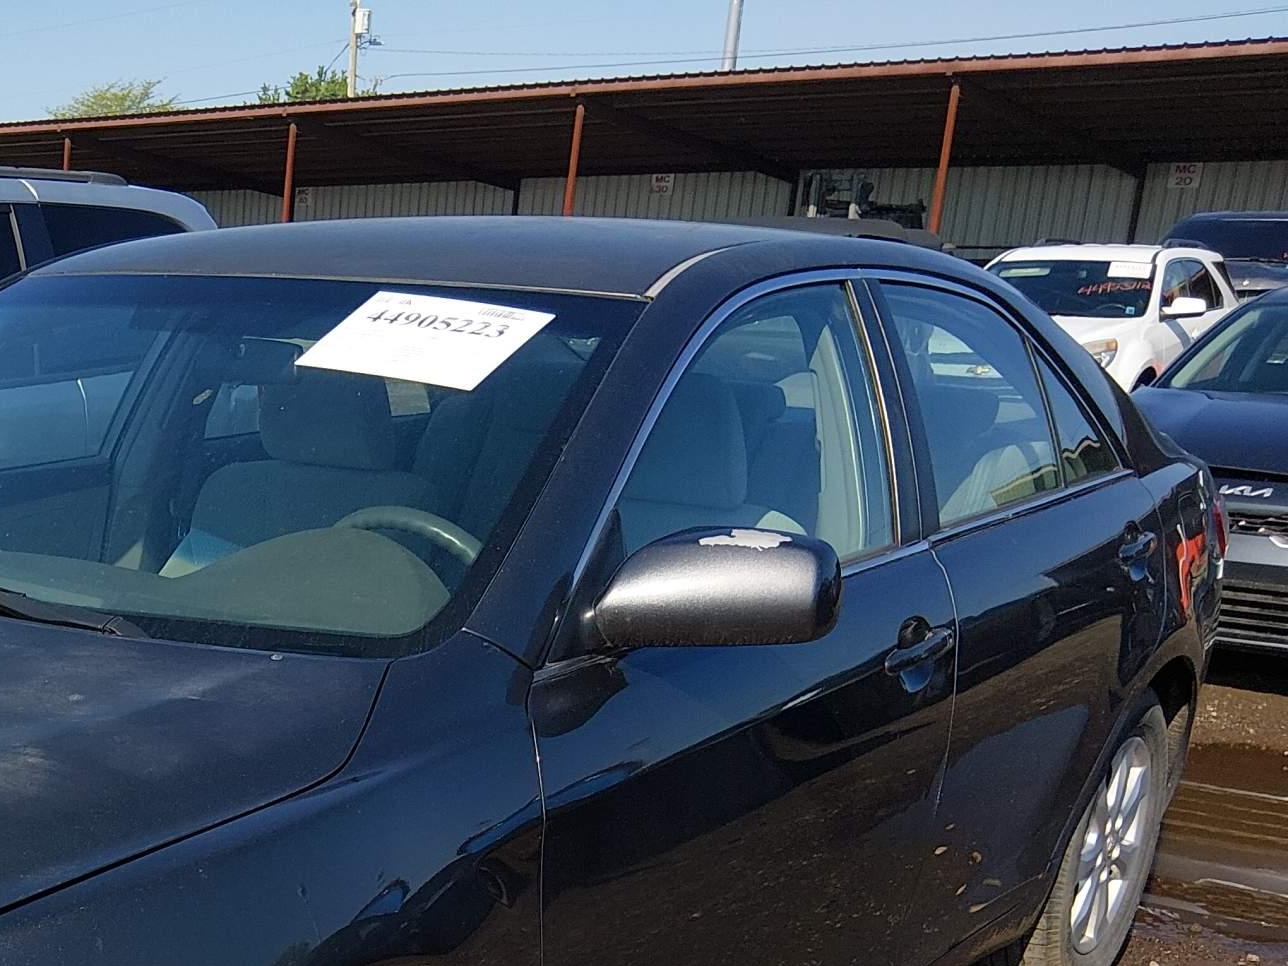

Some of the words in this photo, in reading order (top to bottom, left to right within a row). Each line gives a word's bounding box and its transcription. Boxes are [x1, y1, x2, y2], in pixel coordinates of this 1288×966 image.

[1175, 164, 1197, 174] MC
[1175, 176, 1193, 186] 20
[367, 309, 510, 338] 44905223
